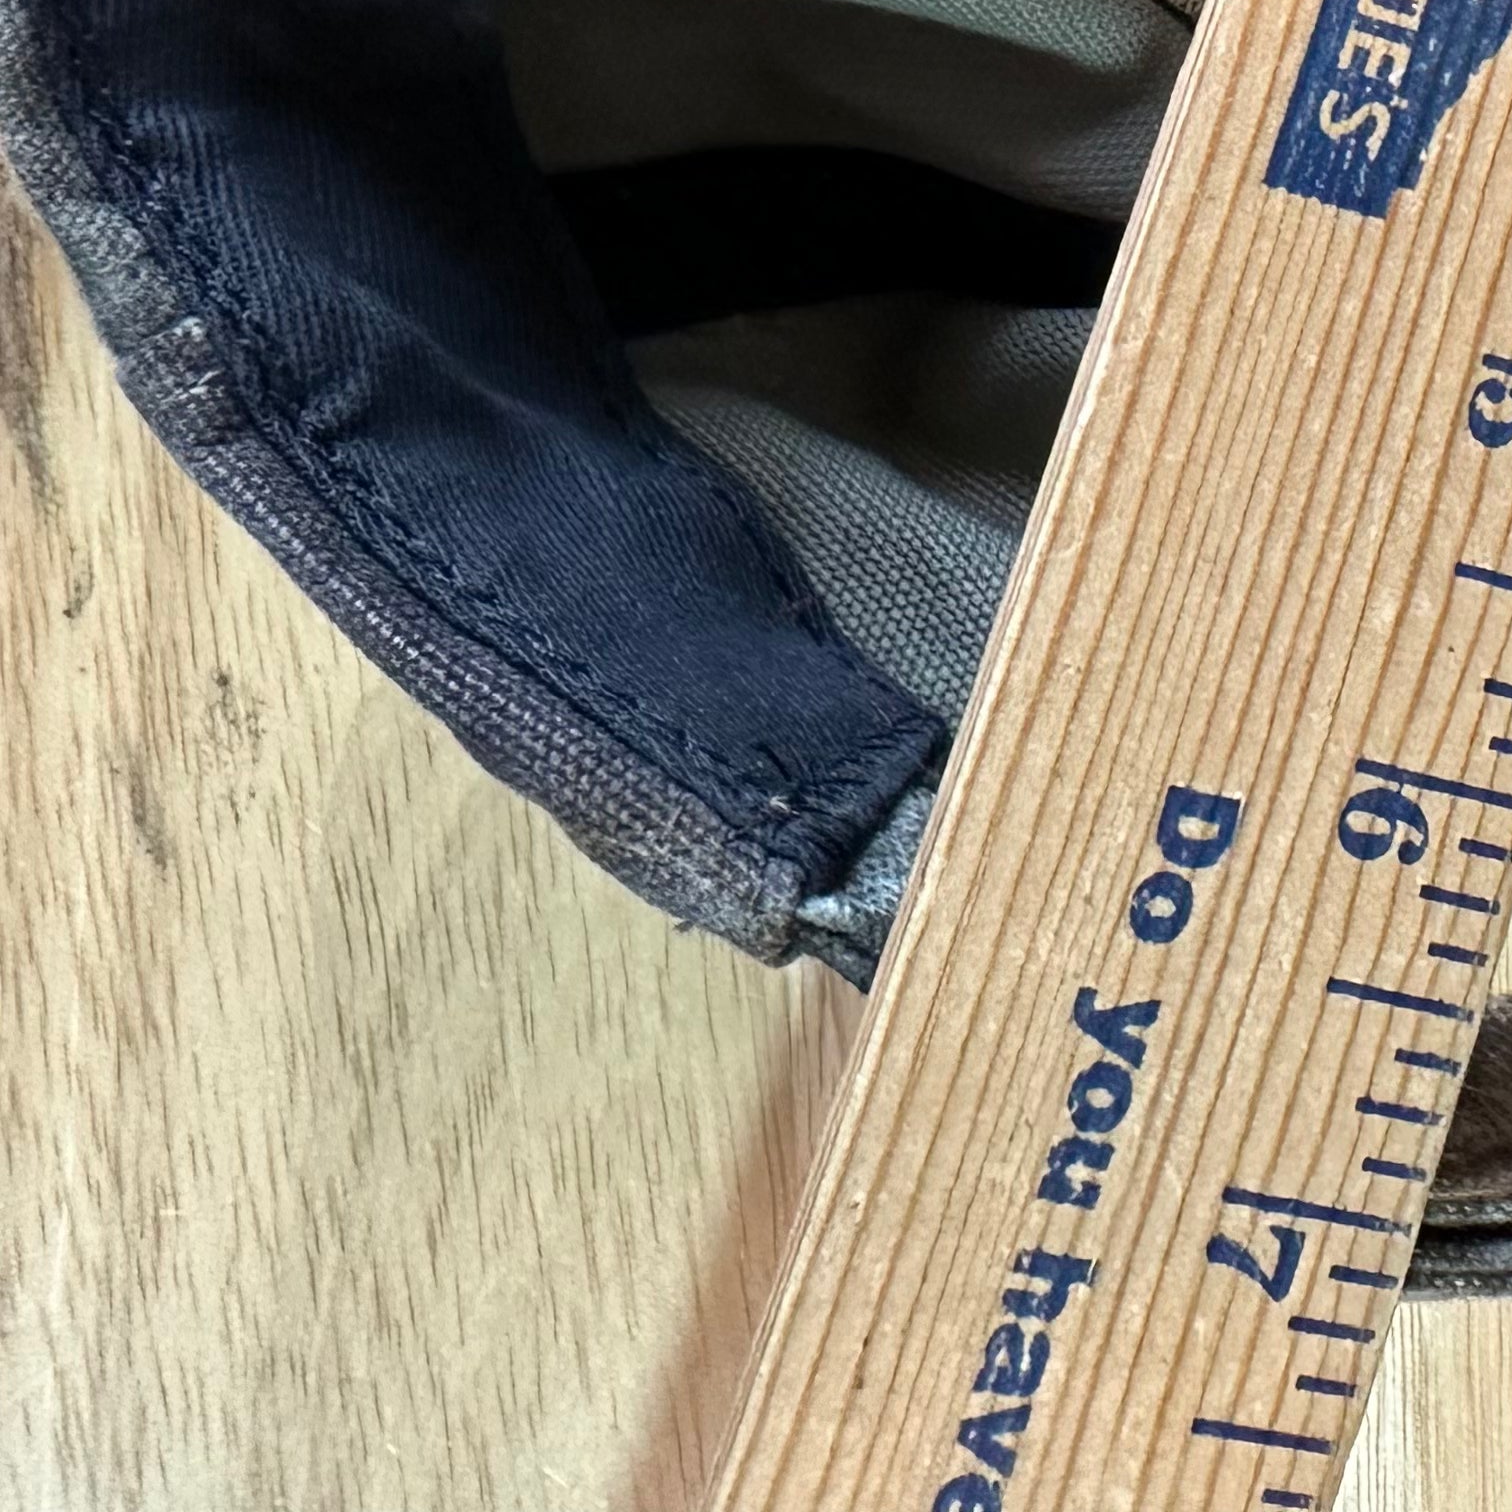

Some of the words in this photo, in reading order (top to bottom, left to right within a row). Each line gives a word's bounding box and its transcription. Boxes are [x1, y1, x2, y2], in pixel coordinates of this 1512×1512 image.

[1129, 785, 1244, 944] Do
[1338, 788, 1429, 865] 6
[1037, 986, 1161, 1210] you
[1207, 1225, 1305, 1304] 7
